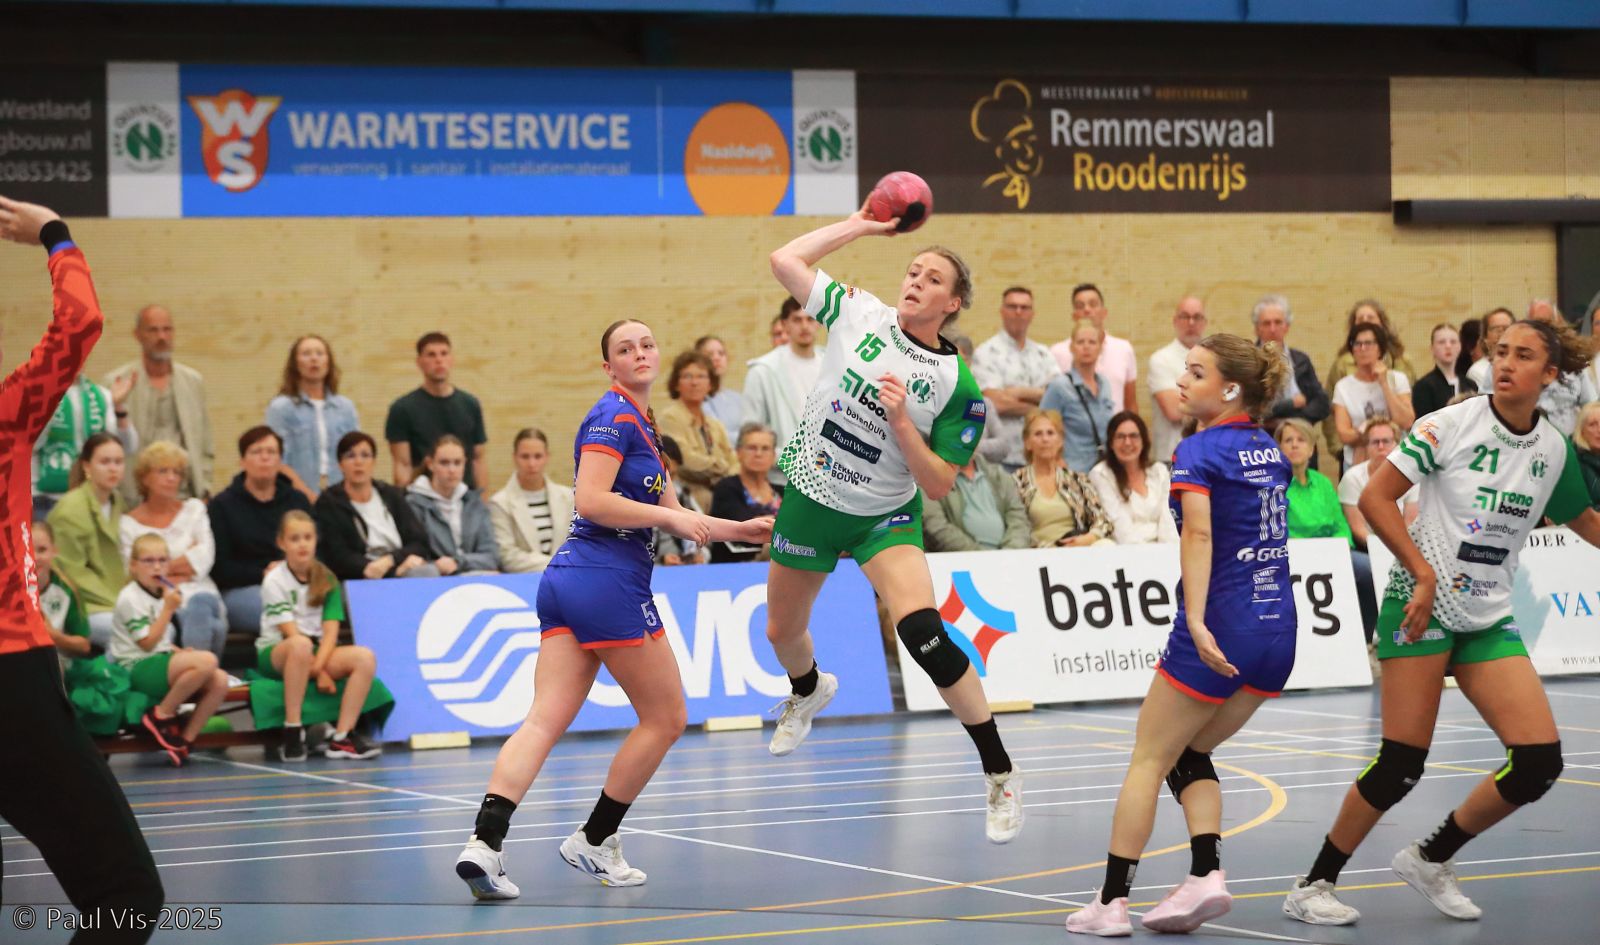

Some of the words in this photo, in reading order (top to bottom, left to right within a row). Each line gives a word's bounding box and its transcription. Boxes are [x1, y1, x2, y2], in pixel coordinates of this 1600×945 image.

[1041, 86, 1140, 100] MEESTERBAKKER
[195, 101, 274, 137] W
[288, 112, 631, 150] WARMTESERVICE
[1050, 107, 1275, 148] Remmerswaal
[216, 140, 257, 189] S
[294, 161, 388, 180] verwarming
[1073, 152, 1247, 201] Roodenrijs
[854, 332, 887, 362] 15
[858, 392, 889, 422] boos
[1237, 447, 1282, 467] FLOOR
[1468, 444, 1500, 475] 21
[830, 469, 859, 486] BOUW
[1257, 485, 1287, 542] 16
[1498, 502, 1530, 519] boost
[1524, 533, 1566, 548] DER
[640, 601, 658, 627] 5
[1039, 566, 1341, 637] bateg
